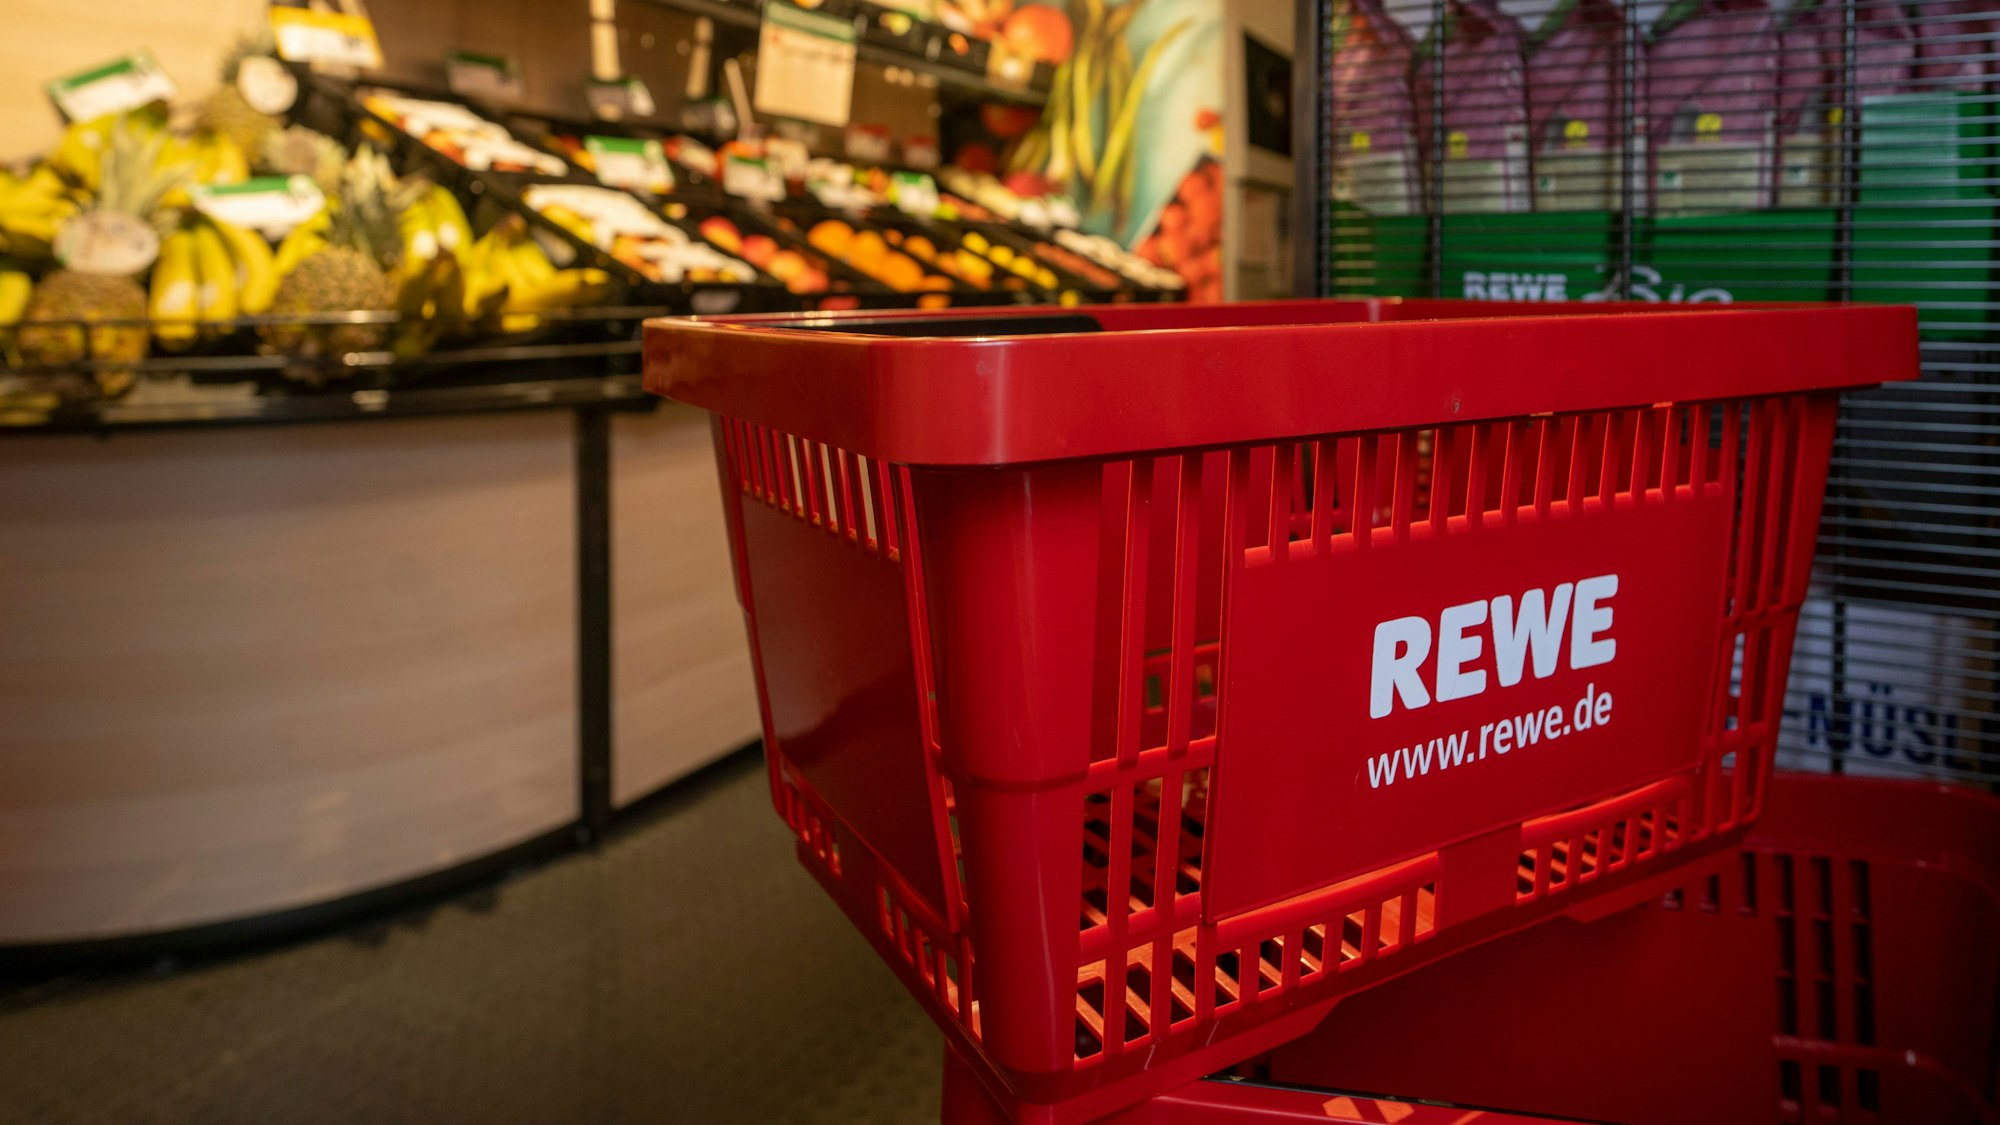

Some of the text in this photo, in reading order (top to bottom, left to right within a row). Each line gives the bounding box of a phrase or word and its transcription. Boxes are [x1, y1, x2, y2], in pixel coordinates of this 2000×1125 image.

[1462, 271, 1568, 302] REWE
[1370, 575, 1619, 719] REWE
[1367, 684, 1614, 789] www.rewe.de
